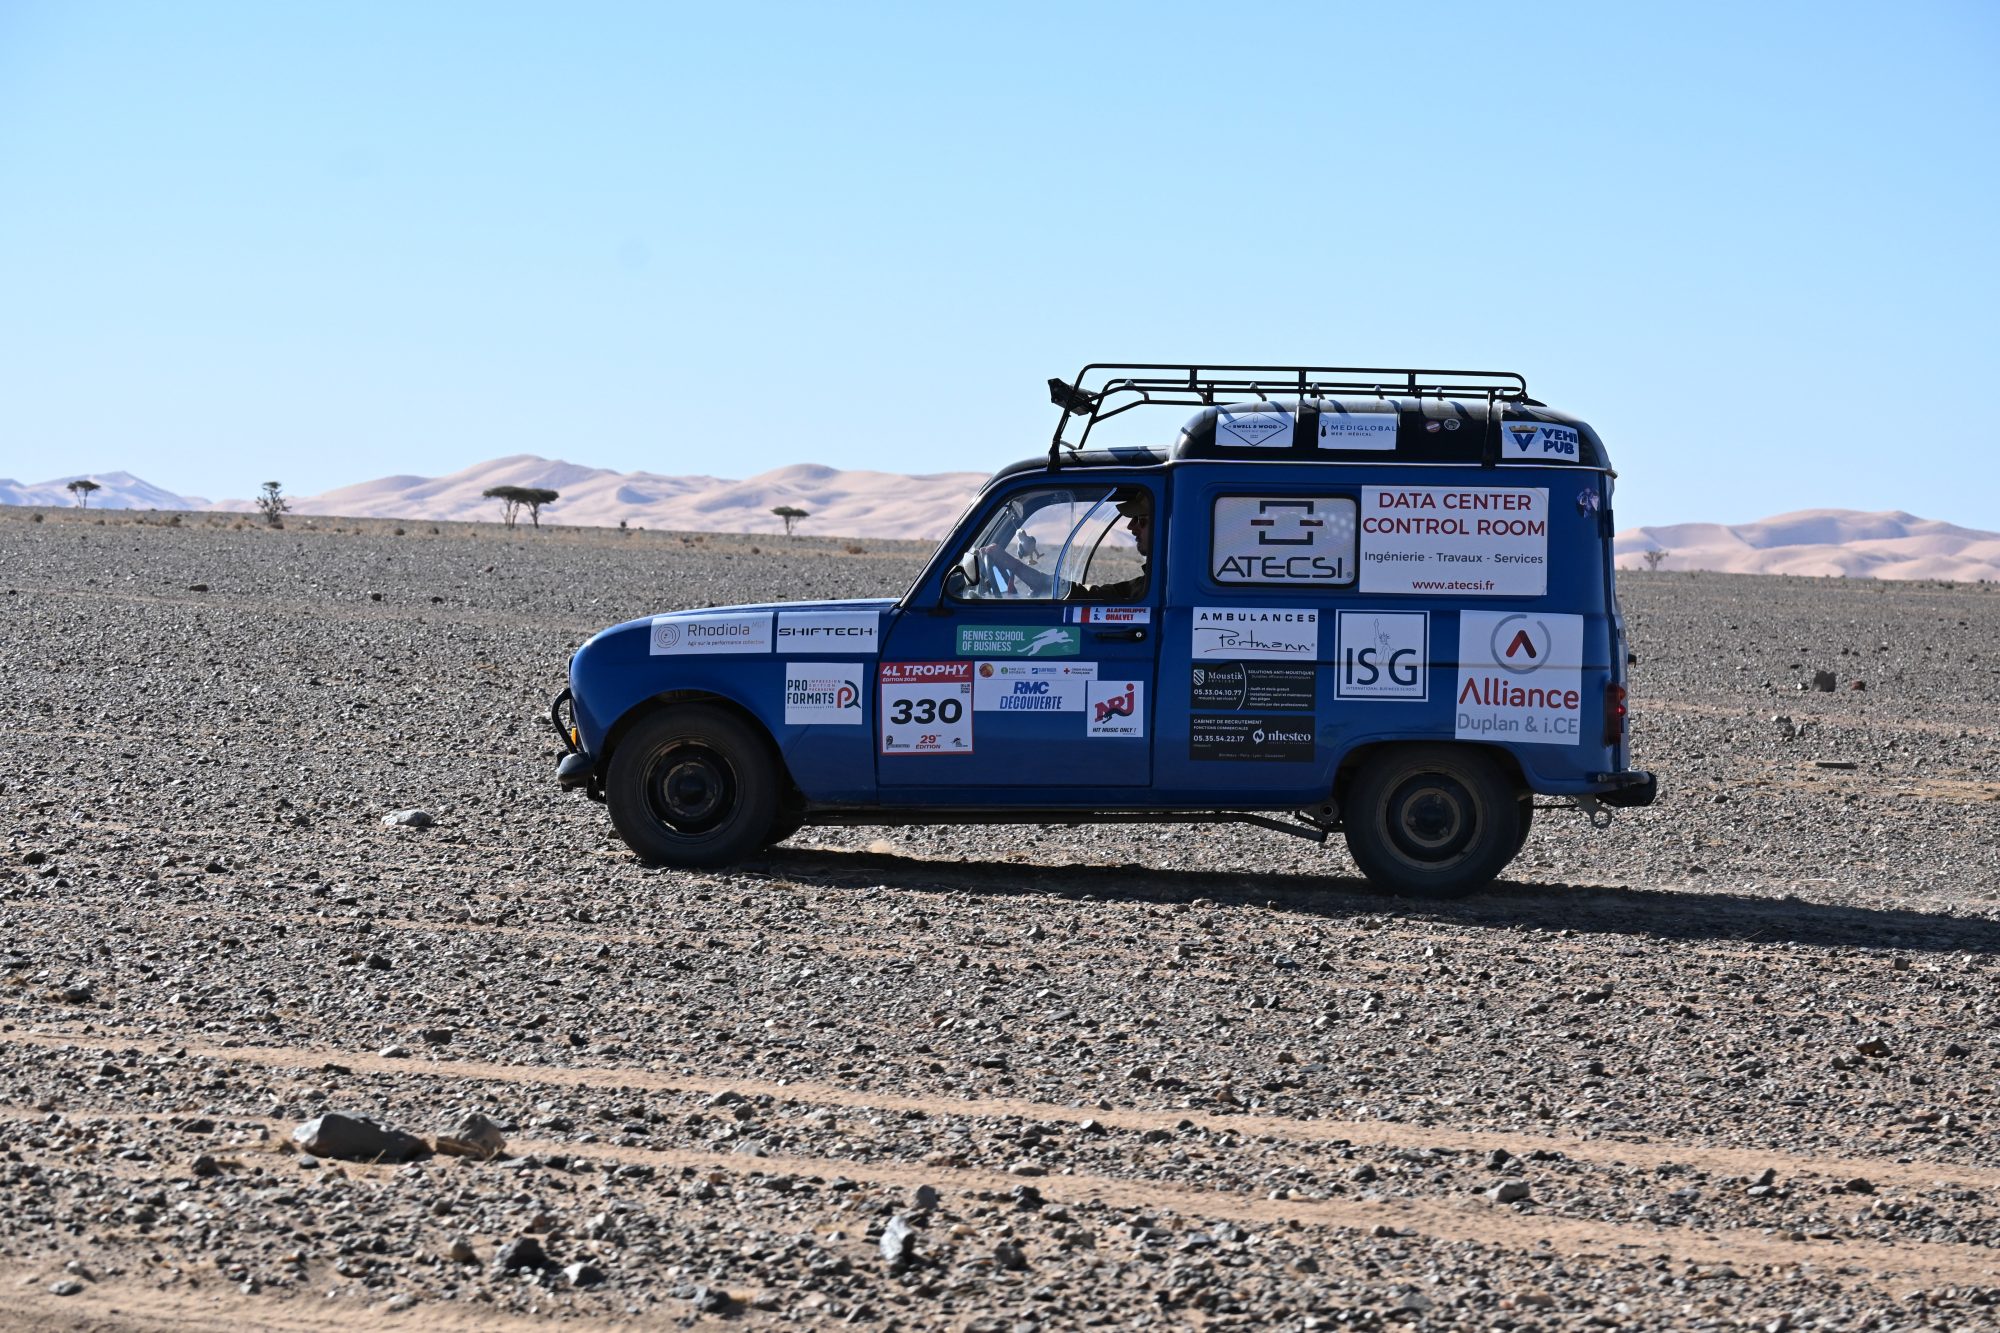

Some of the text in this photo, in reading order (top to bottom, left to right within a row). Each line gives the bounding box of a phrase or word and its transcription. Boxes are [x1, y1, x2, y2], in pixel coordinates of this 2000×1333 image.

[1540, 428, 1577, 444] VEHI
[1543, 440, 1574, 454] PUB
[1378, 492, 1532, 511] DATA CENTER
[1362, 516, 1546, 537] CONTROL ROOM
[1364, 551, 1425, 565] Ingénierie
[1436, 552, 1482, 563] Travaux
[1494, 552, 1543, 564] Services
[1216, 556, 1342, 578] ATECSI
[1412, 579, 1494, 592] www.atecsi.fr
[1200, 613, 1316, 622] AMBULANCES
[687, 623, 750, 637] Rhodiola
[779, 628, 873, 636] SHIFTECH
[962, 630, 1025, 641] RENNES SCHOOL
[962, 641, 1011, 652] OF BUSINESS
[1194, 627, 1310, 652] Portmann
[882, 665, 968, 676] 4L TROPHY
[1346, 648, 1417, 686] ISG
[1208, 672, 1243, 680] Moustik
[787, 680, 808, 691] PRO
[1014, 681, 1049, 694] RMC
[787, 692, 834, 704] FORMATS
[1459, 677, 1579, 709] Alliance
[1000, 695, 1062, 710] DÉCOUVERTE
[1094, 683, 1135, 723] NRJ
[890, 698, 962, 724] 330
[1457, 713, 1578, 735] Duplan & i.CE
[1268, 730, 1311, 741] nhesteo
